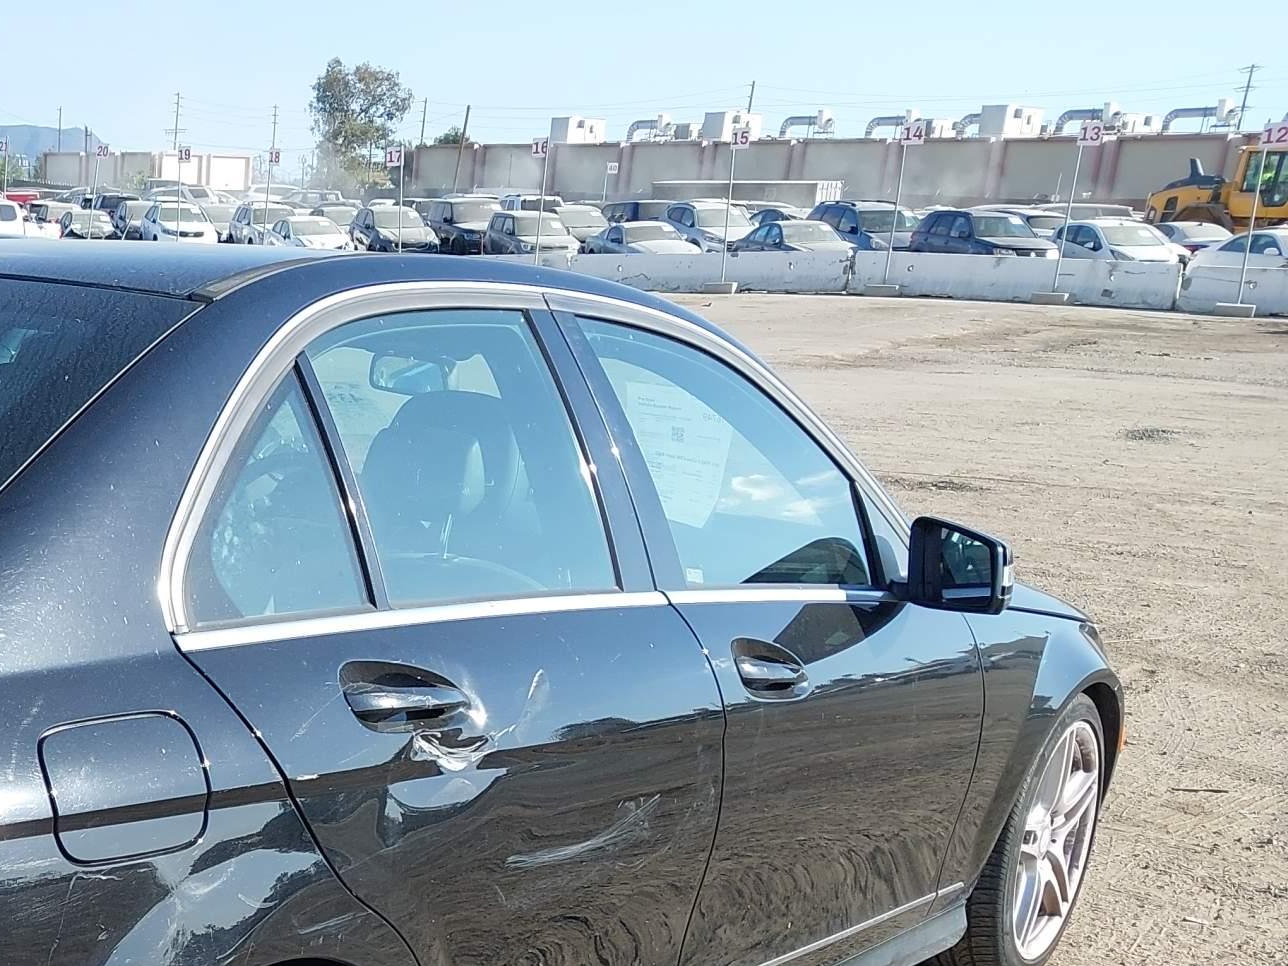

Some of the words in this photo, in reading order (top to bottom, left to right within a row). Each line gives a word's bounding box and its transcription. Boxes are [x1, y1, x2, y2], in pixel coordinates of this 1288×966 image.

[731, 131, 750, 145] 15
[903, 125, 924, 141] 14
[1079, 126, 1101, 142] 13
[1262, 126, 1288, 145] 12
[96, 145, 109, 157] 20
[532, 141, 548, 154] 16
[178, 148, 191, 161] 19
[268, 151, 281, 164] 18
[387, 150, 401, 163] 17
